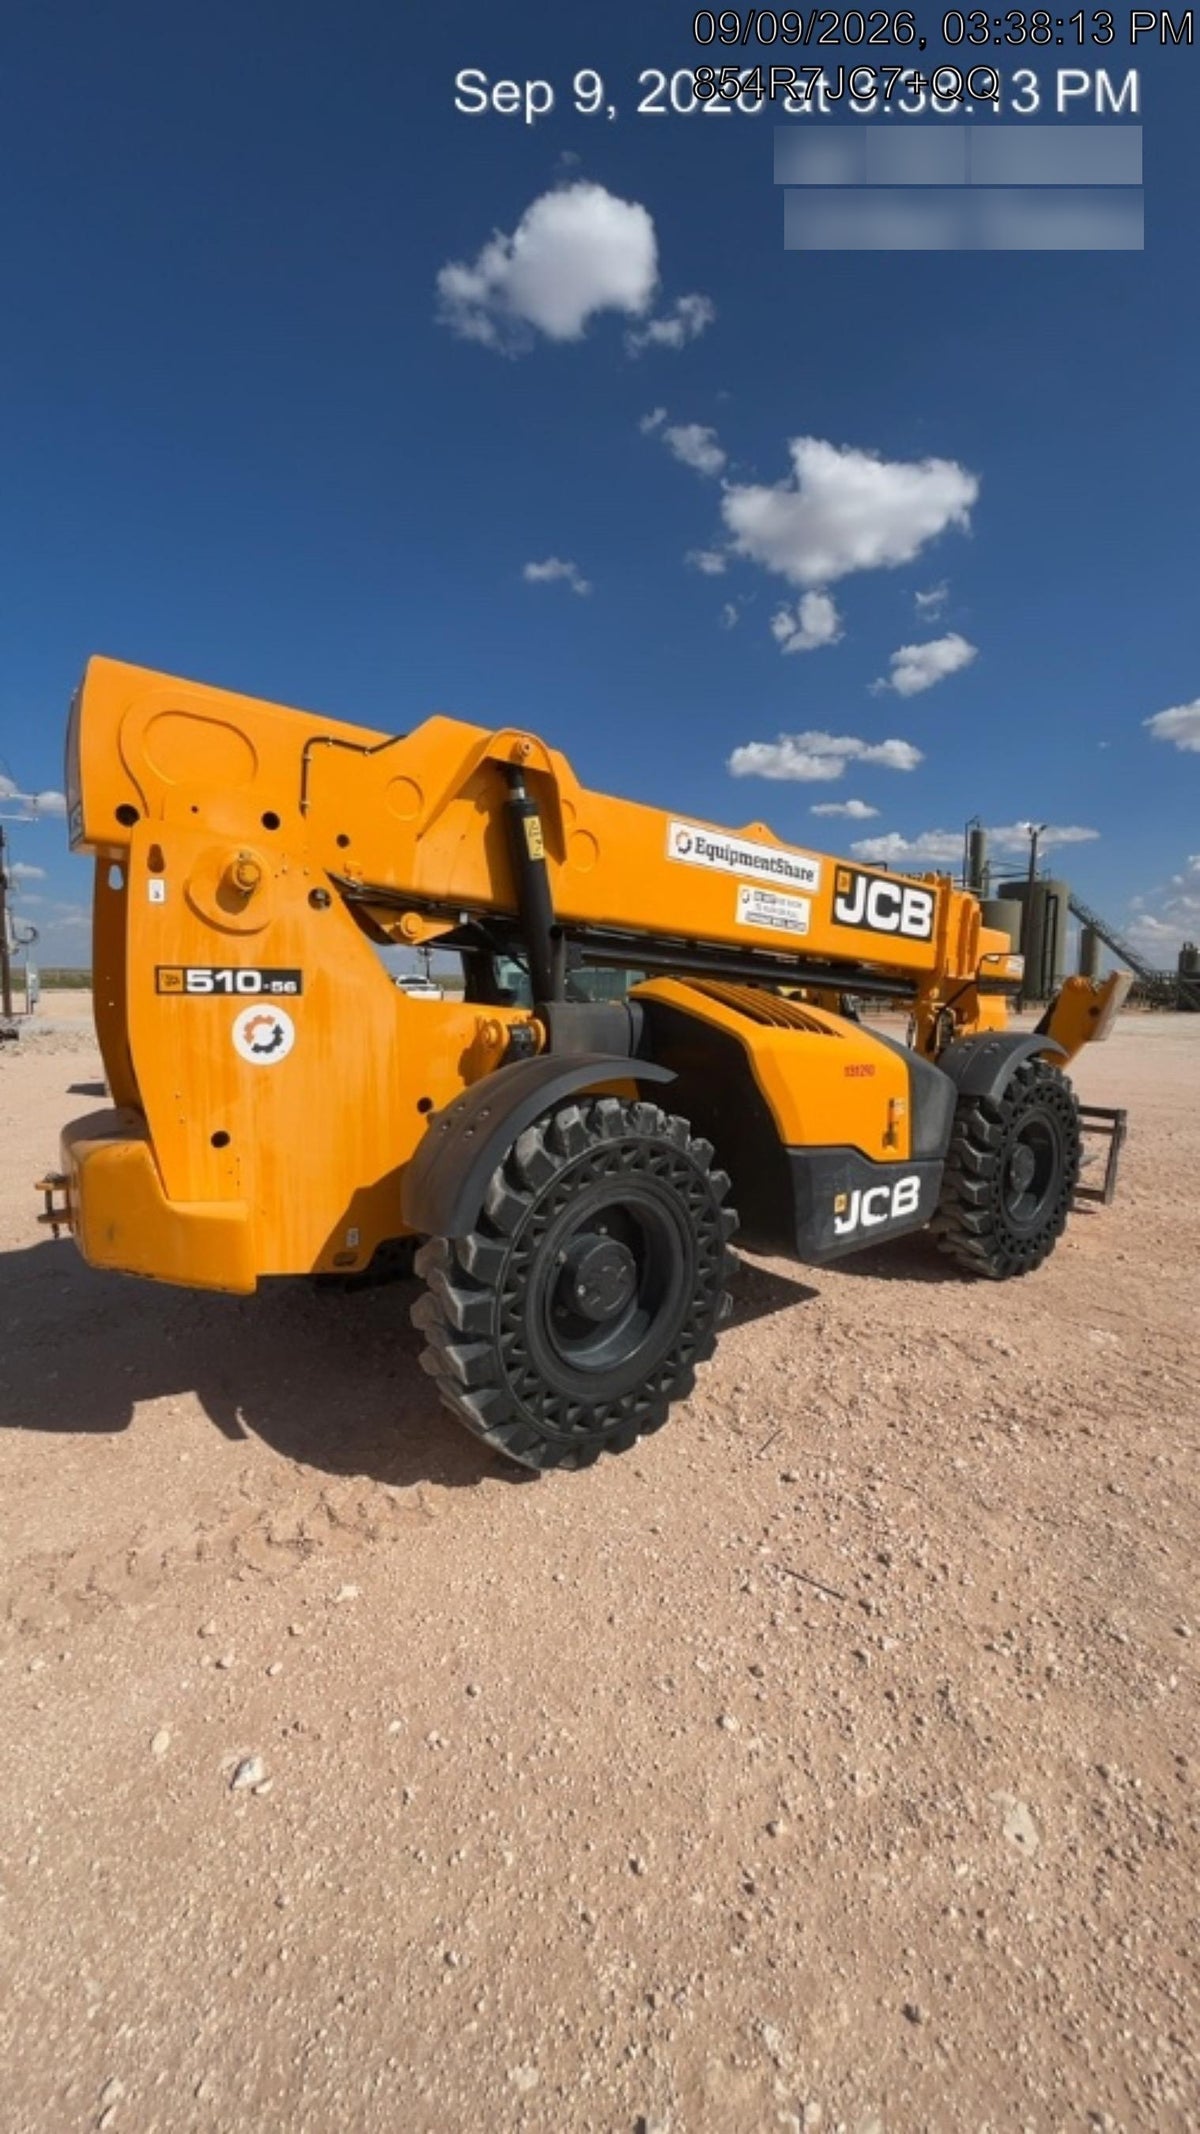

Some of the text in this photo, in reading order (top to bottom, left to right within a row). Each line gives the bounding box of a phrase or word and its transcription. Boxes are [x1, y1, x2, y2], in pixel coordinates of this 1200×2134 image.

[693, 836, 815, 883] EquipmentShare
[834, 874, 934, 938] JCB
[185, 968, 298, 993] 510-56
[833, 1175, 921, 1235] JCB
